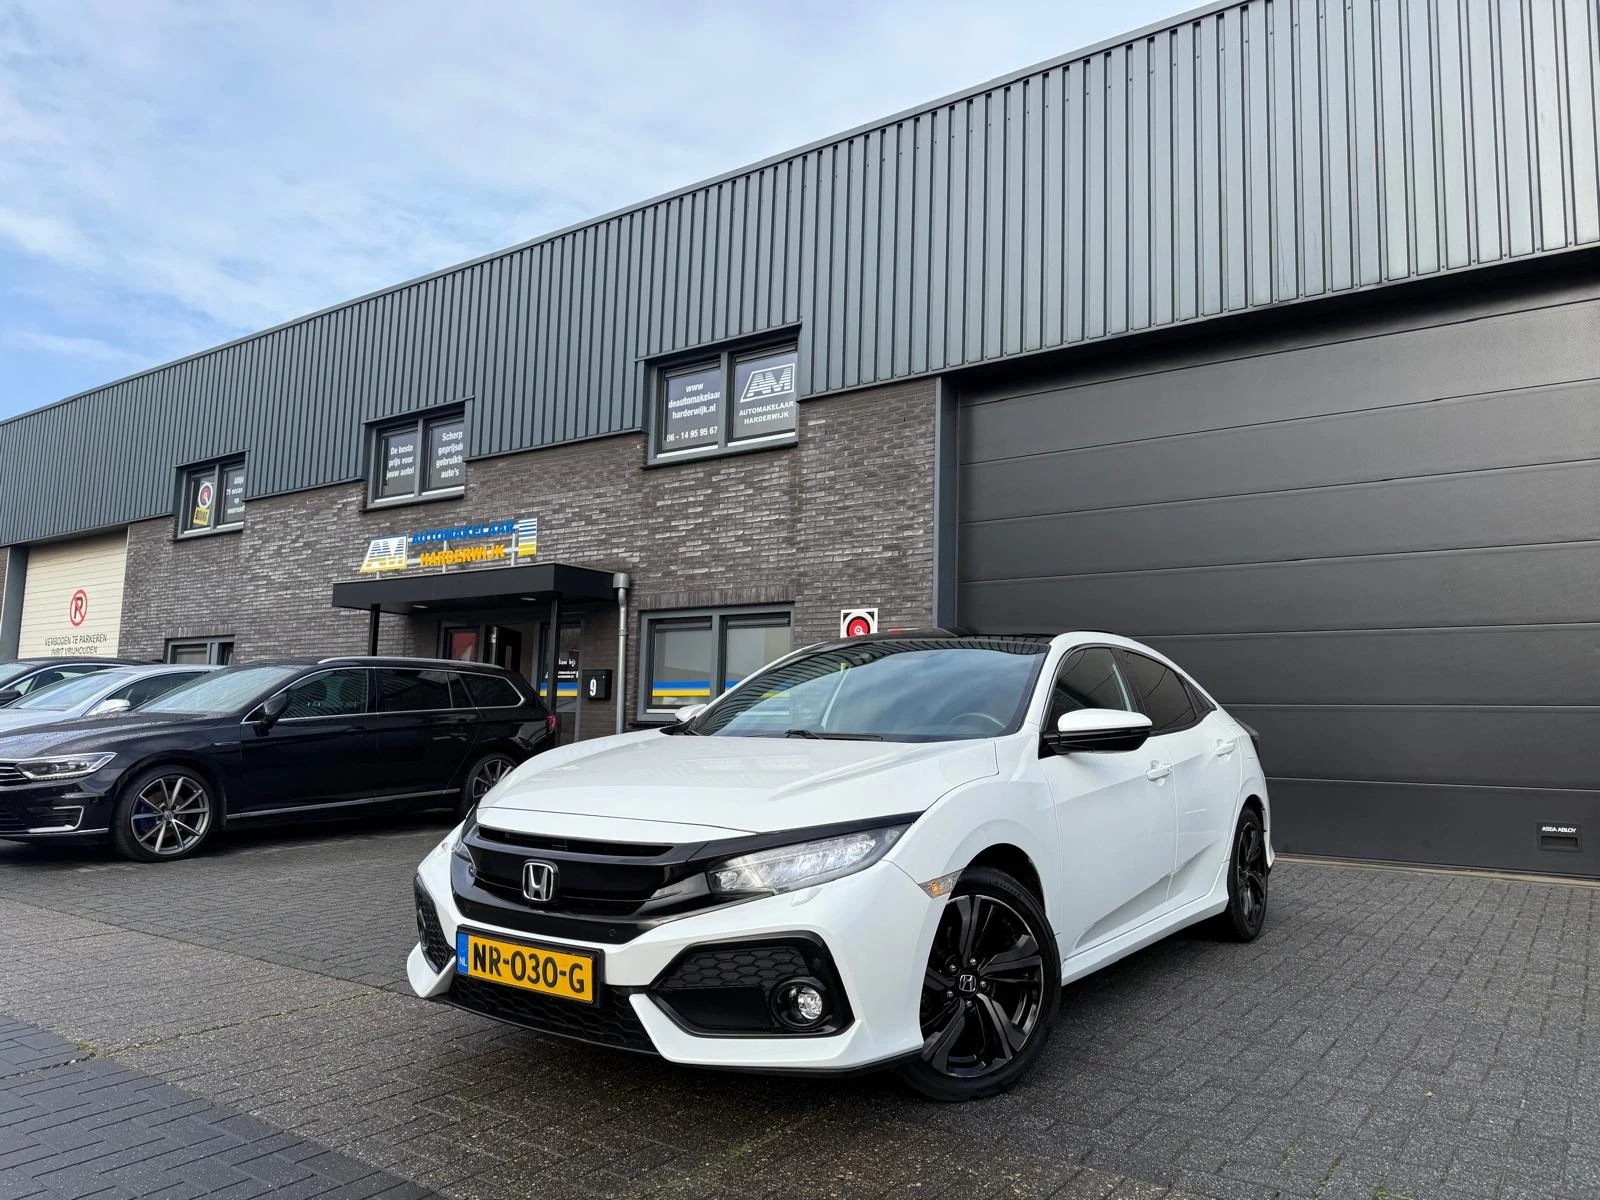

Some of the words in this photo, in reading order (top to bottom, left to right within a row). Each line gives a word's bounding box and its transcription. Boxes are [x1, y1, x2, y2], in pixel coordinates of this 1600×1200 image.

[686, 383, 704, 392] www
[668, 392, 720, 408] deautomakelaar
[672, 403, 716, 419] harderwijk.nl
[739, 401, 794, 416] AUTOMAKELAAR
[744, 411, 789, 425] HARDERWIJK
[442, 431, 463, 441] Scherp
[681, 431, 689, 439] 14
[391, 447, 398, 455] De
[399, 444, 413, 453] beste
[402, 456, 413, 464] voor
[441, 468, 460, 478] auto's
[412, 519, 515, 544] AUTOMAKELAAR
[419, 544, 505, 566] HARDERWIJK
[45, 636, 71, 647] VERBODEN
[72, 635, 78, 644] TE
[79, 633, 107, 643] PARKEREN
[589, 678, 597, 696] 9
[458, 957, 467, 967] NL
[473, 942, 585, 994] NR-030-G
